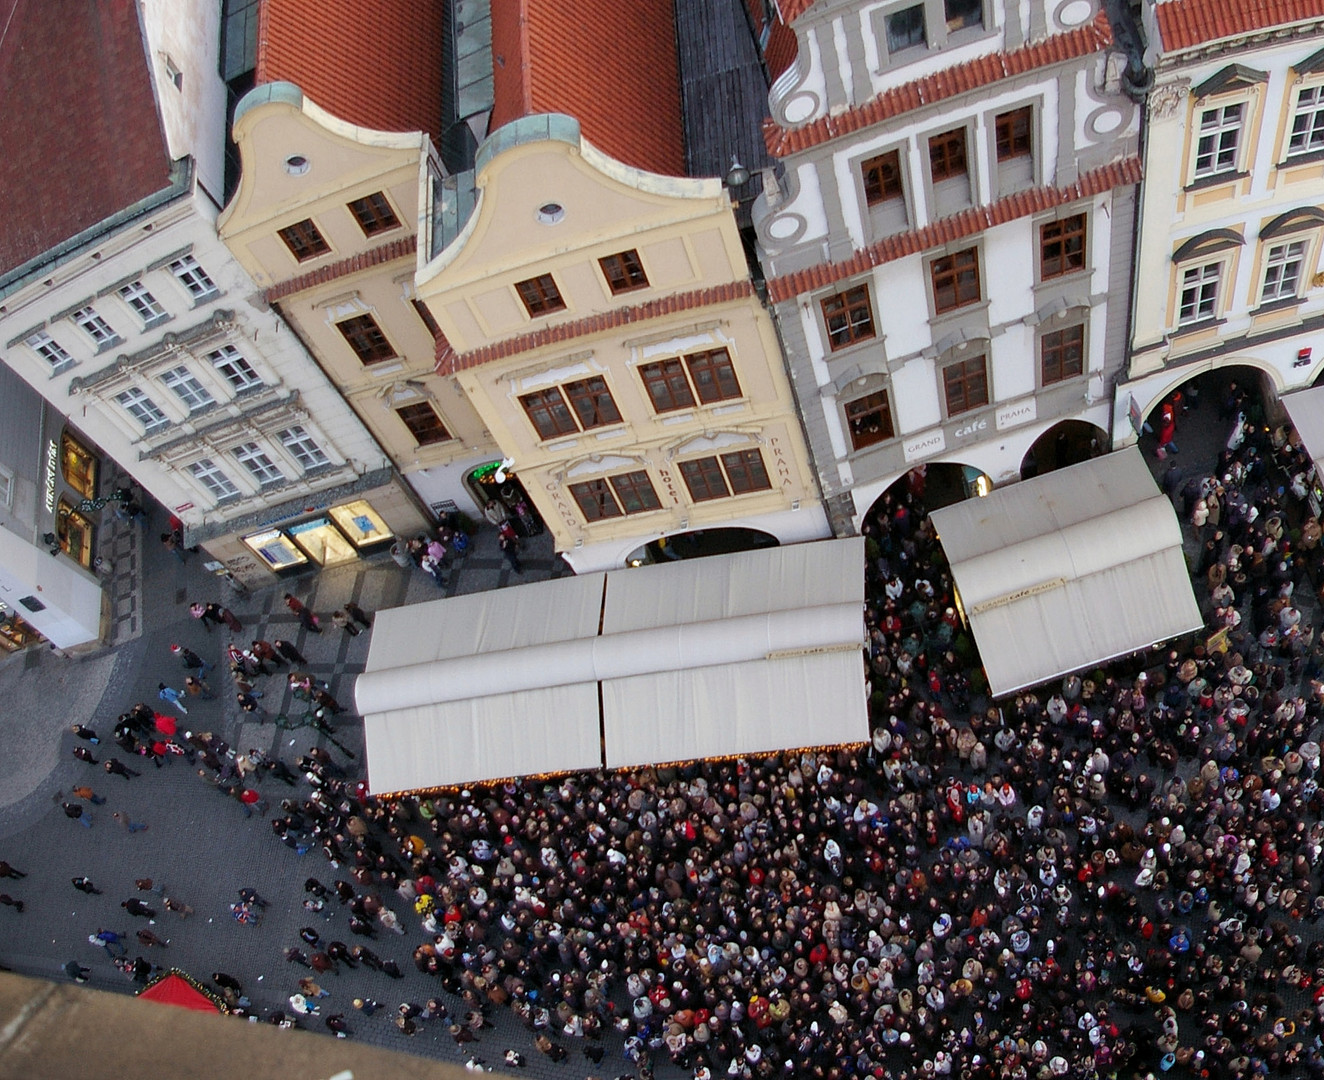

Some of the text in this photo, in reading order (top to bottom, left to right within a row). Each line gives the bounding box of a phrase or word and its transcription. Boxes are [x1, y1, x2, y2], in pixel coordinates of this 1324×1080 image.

[907, 406, 1031, 454] GRAND café PRAHA
[770, 437, 792, 486] PRAHA
[545, 482, 577, 527] GRAND
[659, 469, 679, 505] hotel
